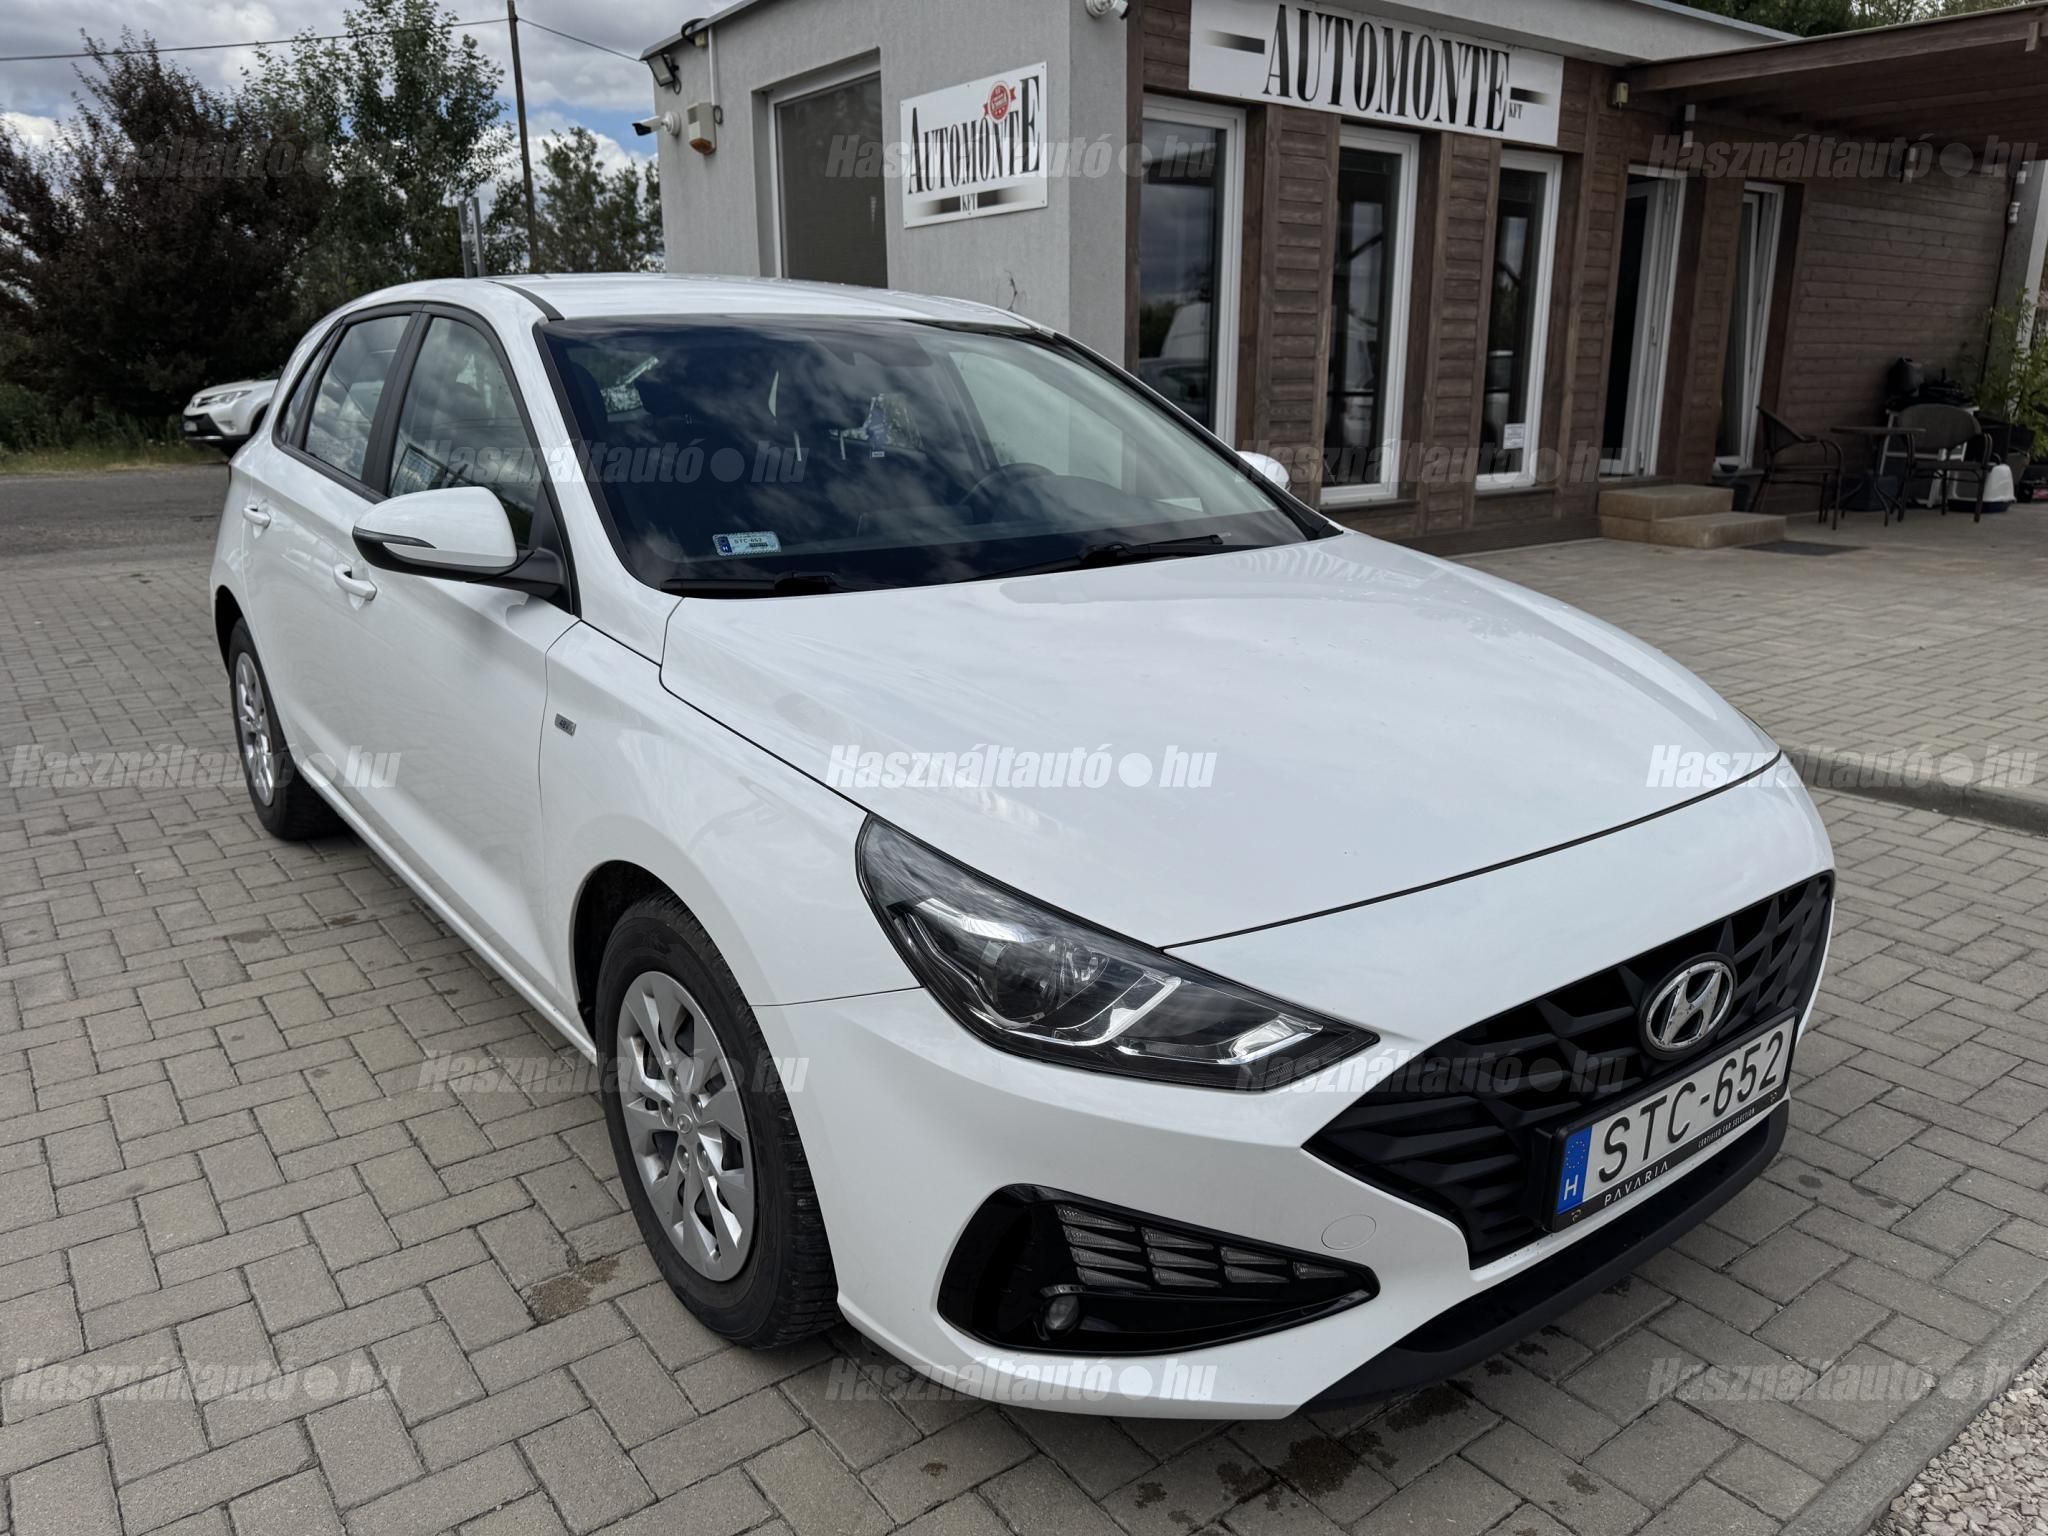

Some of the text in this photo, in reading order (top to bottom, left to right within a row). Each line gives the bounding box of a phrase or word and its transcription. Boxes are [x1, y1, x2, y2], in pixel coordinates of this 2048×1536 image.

[1262, 4, 1510, 132] AUTOMONTE
[962, 194, 977, 212] KFT
[1563, 1030, 1784, 1201] H STC-652
[1604, 1160, 1669, 1206] PAVARIA
